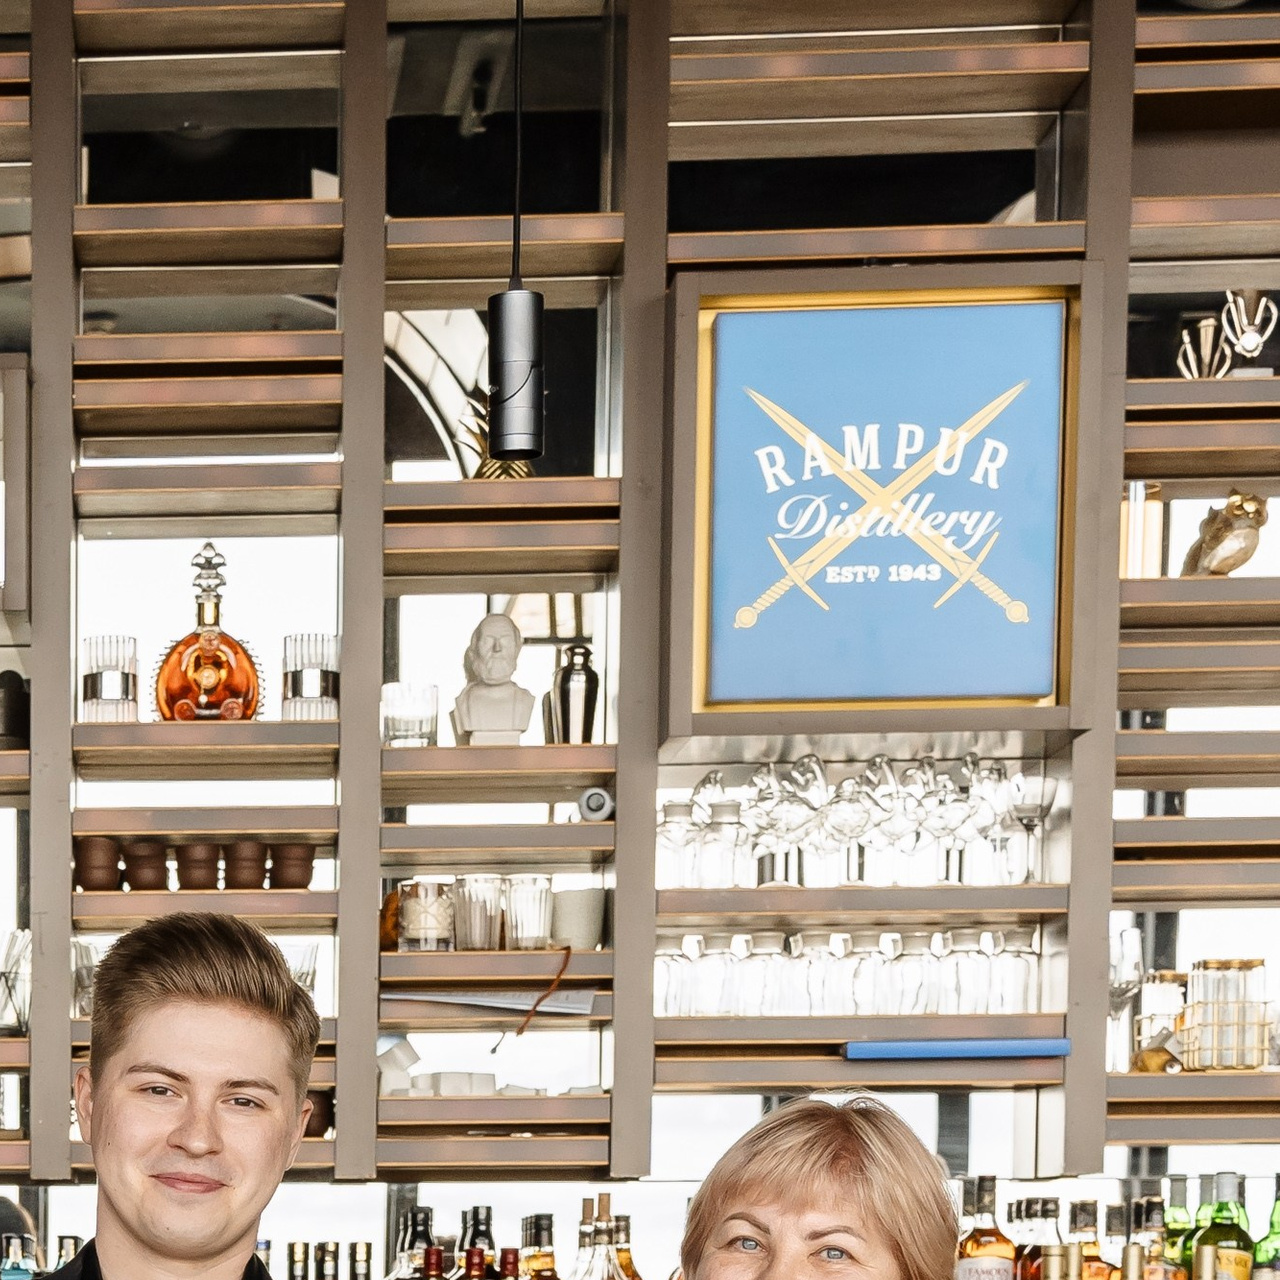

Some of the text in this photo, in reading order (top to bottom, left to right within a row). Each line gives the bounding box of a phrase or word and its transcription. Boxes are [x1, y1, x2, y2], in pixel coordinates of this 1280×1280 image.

[754, 423, 1009, 493] RAMPUR
[774, 492, 1004, 553] Distillery
[887, 563, 942, 582] 1943
